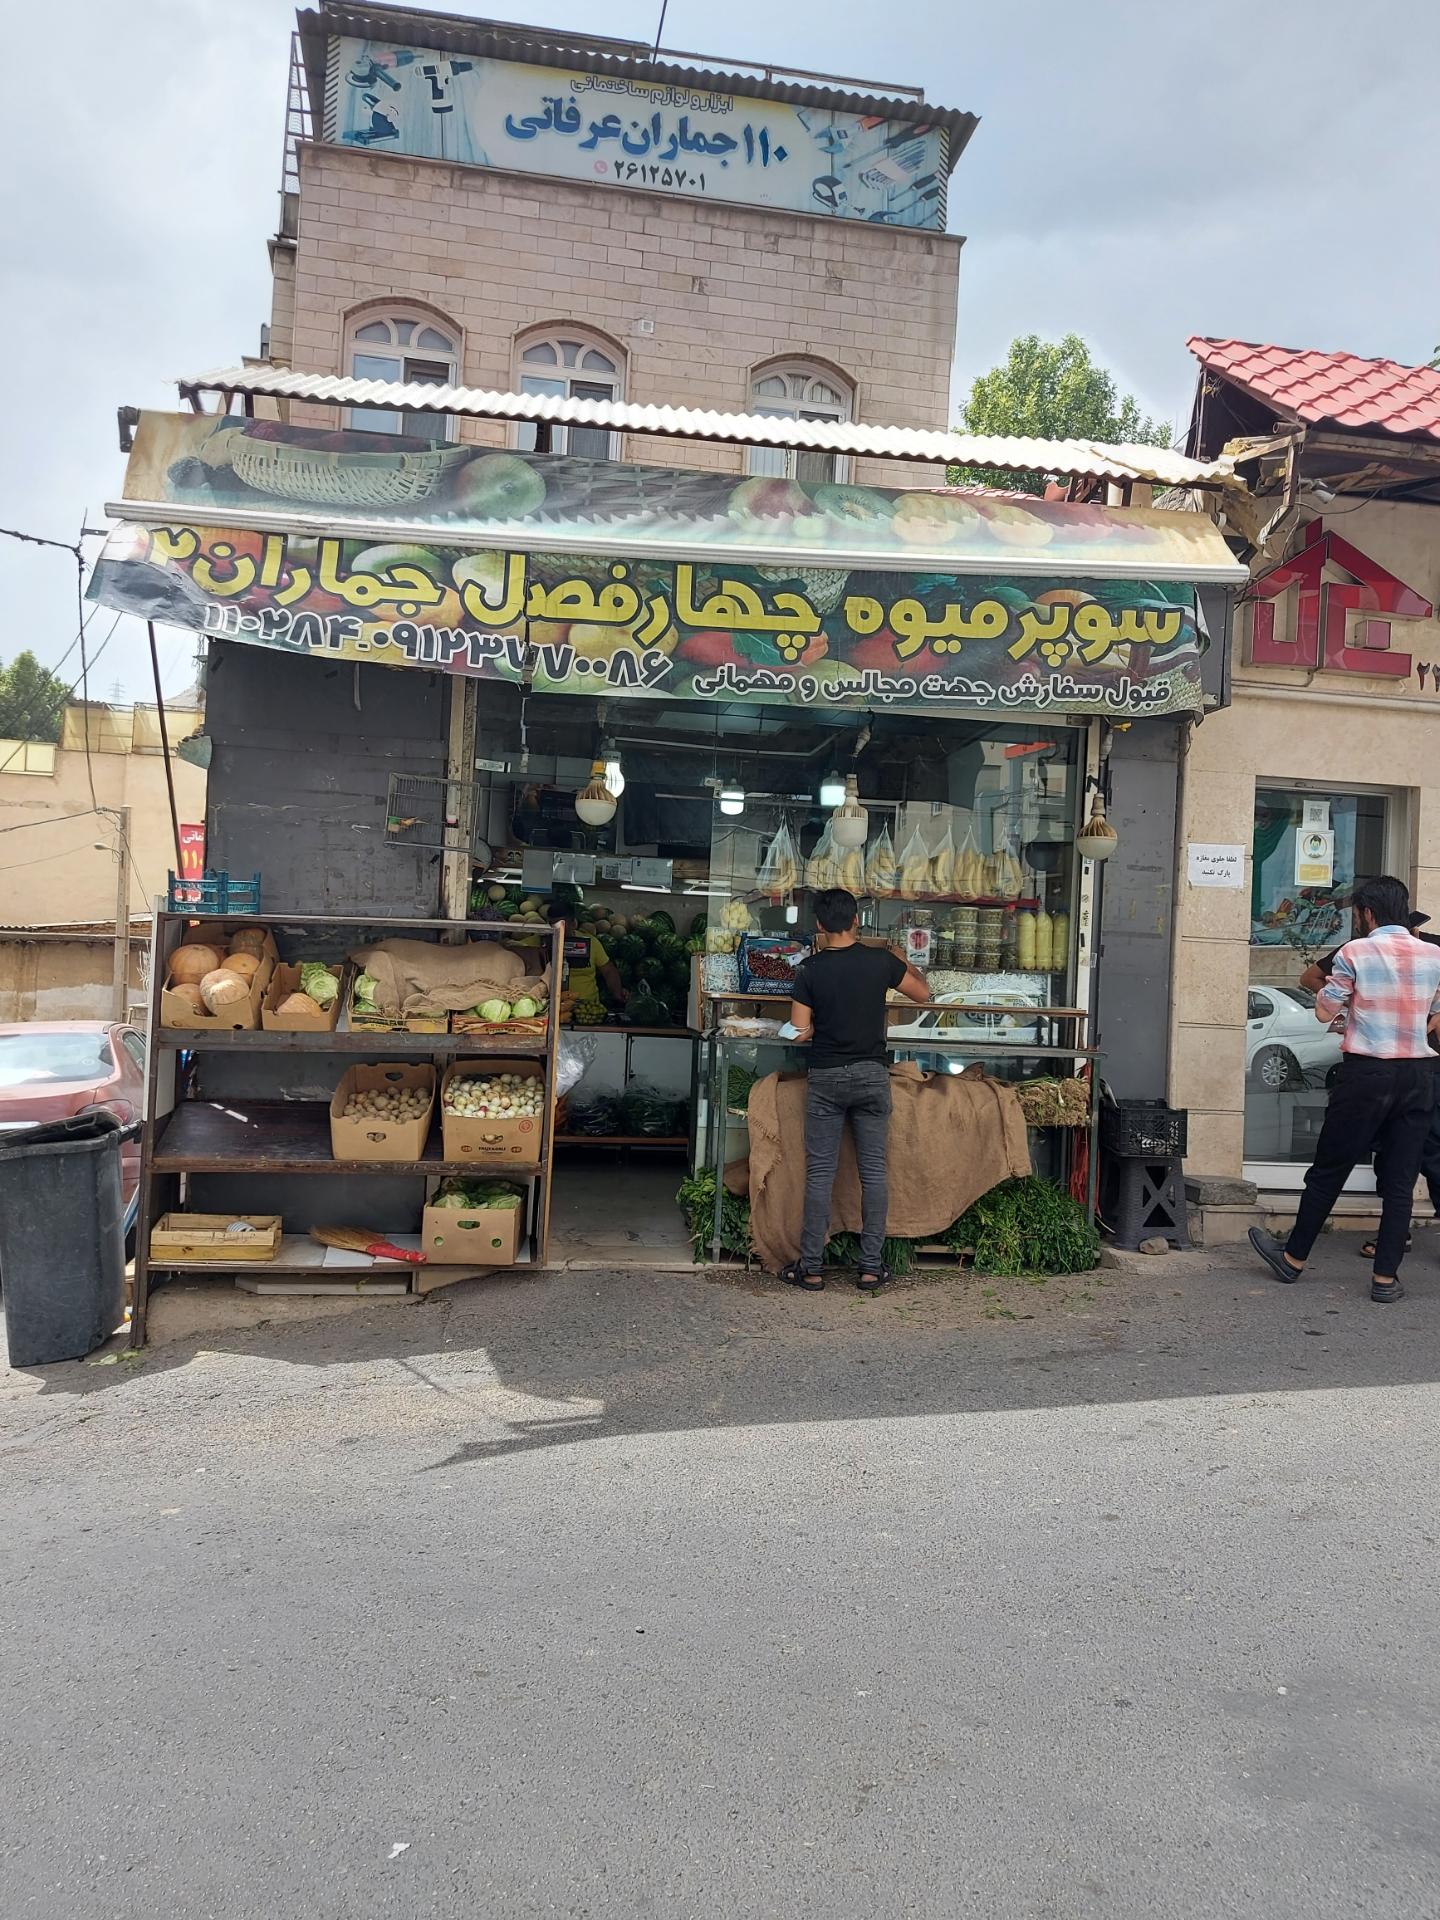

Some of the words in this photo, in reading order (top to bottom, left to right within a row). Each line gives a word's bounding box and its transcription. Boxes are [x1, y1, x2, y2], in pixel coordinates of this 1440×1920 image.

[570, 76, 649, 98] ساختمانی
[650, 87, 690, 108] لوازم
[690, 95, 701, 111] و
[700, 93, 733, 114] ابزار
[621, 111, 738, 168] جماران
[743, 123, 788, 167] ۱۱۰
[614, 160, 706, 191] ۲۶۱۲۵۷۰۱
[191, 532, 446, 618] جماران
[843, 594, 1011, 661] میوه
[1006, 600, 1186, 669] سوپر
[692, 662, 796, 696] مهمانی
[798, 674, 819, 703] و
[821, 669, 918, 703] مجالس
[919, 674, 996, 706] جهت
[998, 672, 1103, 709] سفارش
[1105, 675, 1172, 712] قبول
[1217, 869, 1231, 878] پارک
